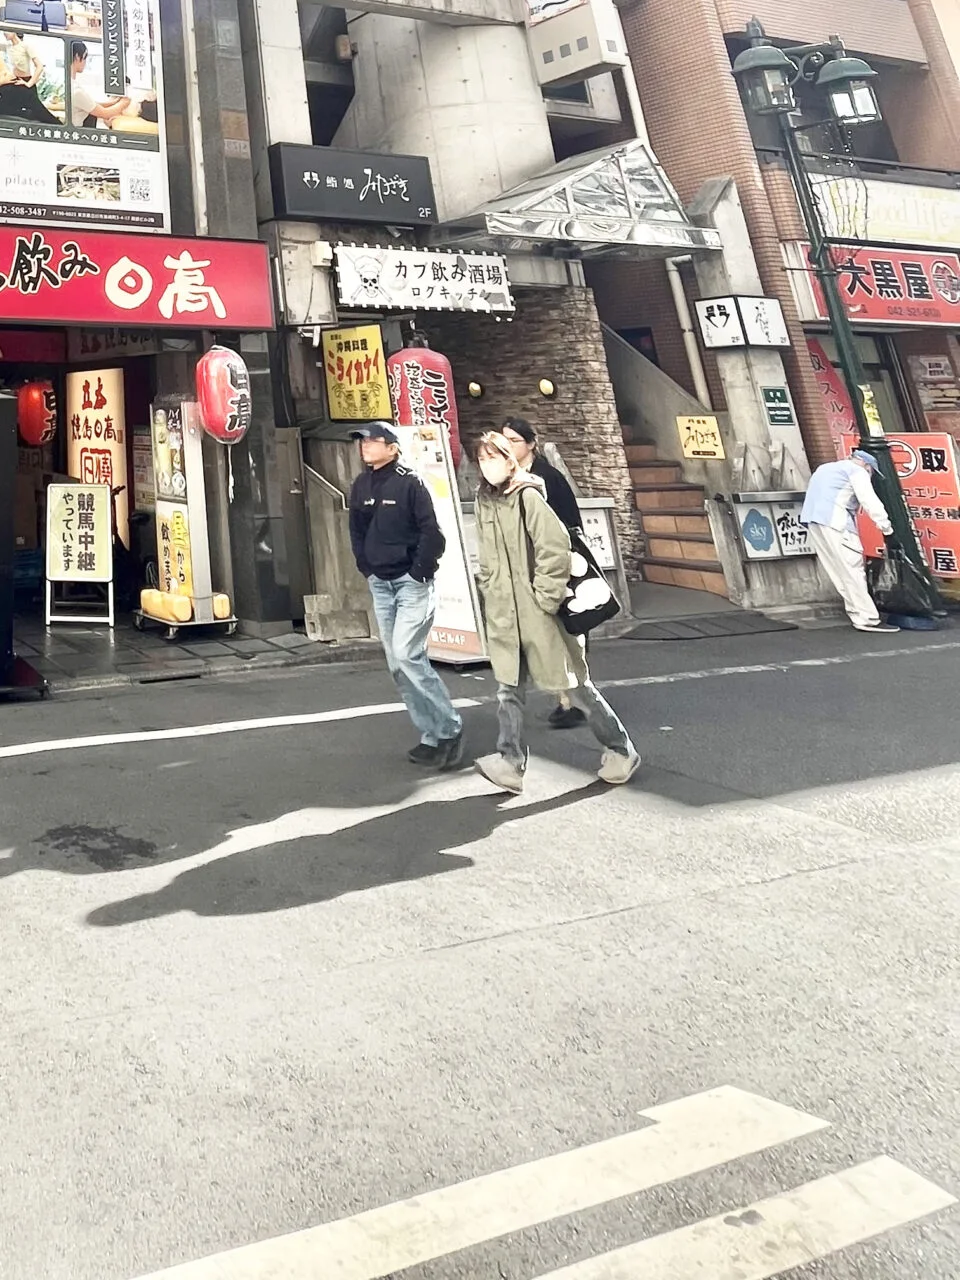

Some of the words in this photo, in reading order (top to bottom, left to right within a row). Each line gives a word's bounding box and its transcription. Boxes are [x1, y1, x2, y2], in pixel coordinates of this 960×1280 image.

[106, 0, 120, 86] マシンピラティス
[5, 173, 47, 189] pilates
[418, 207, 432, 218] 2F
[840, 256, 935, 300] 大黒屋
[327, 348, 380, 387] ニライカナイ
[61, 492, 75, 572] やっています
[77, 492, 96, 572] 競馬中継
[749, 523, 767, 541] sky
